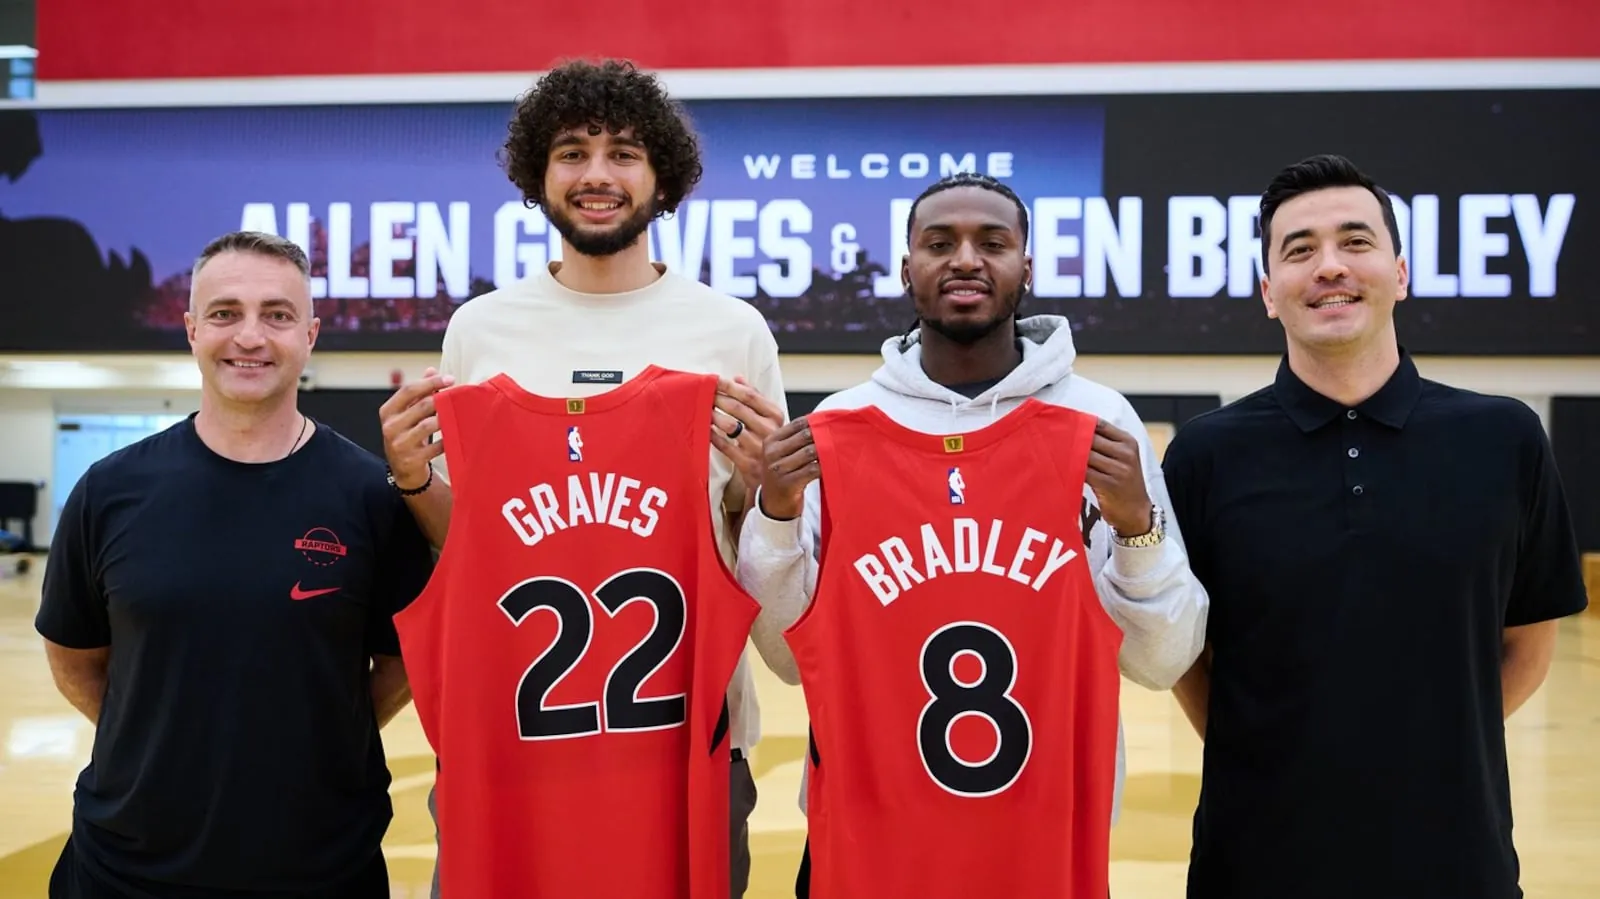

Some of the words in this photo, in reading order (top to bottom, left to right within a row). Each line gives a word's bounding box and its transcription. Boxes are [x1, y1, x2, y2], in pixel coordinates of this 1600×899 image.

[743, 152, 1014, 179] WELCOME
[493, 200, 813, 298] GVES
[830, 223, 859, 274] &
[873, 196, 1143, 298] JEN
[302, 541, 340, 552] RAPTORS
[501, 472, 668, 546] GRAVES
[853, 517, 1078, 607] BRADLEY
[496, 567, 687, 740] 22
[916, 620, 1033, 798] 8
